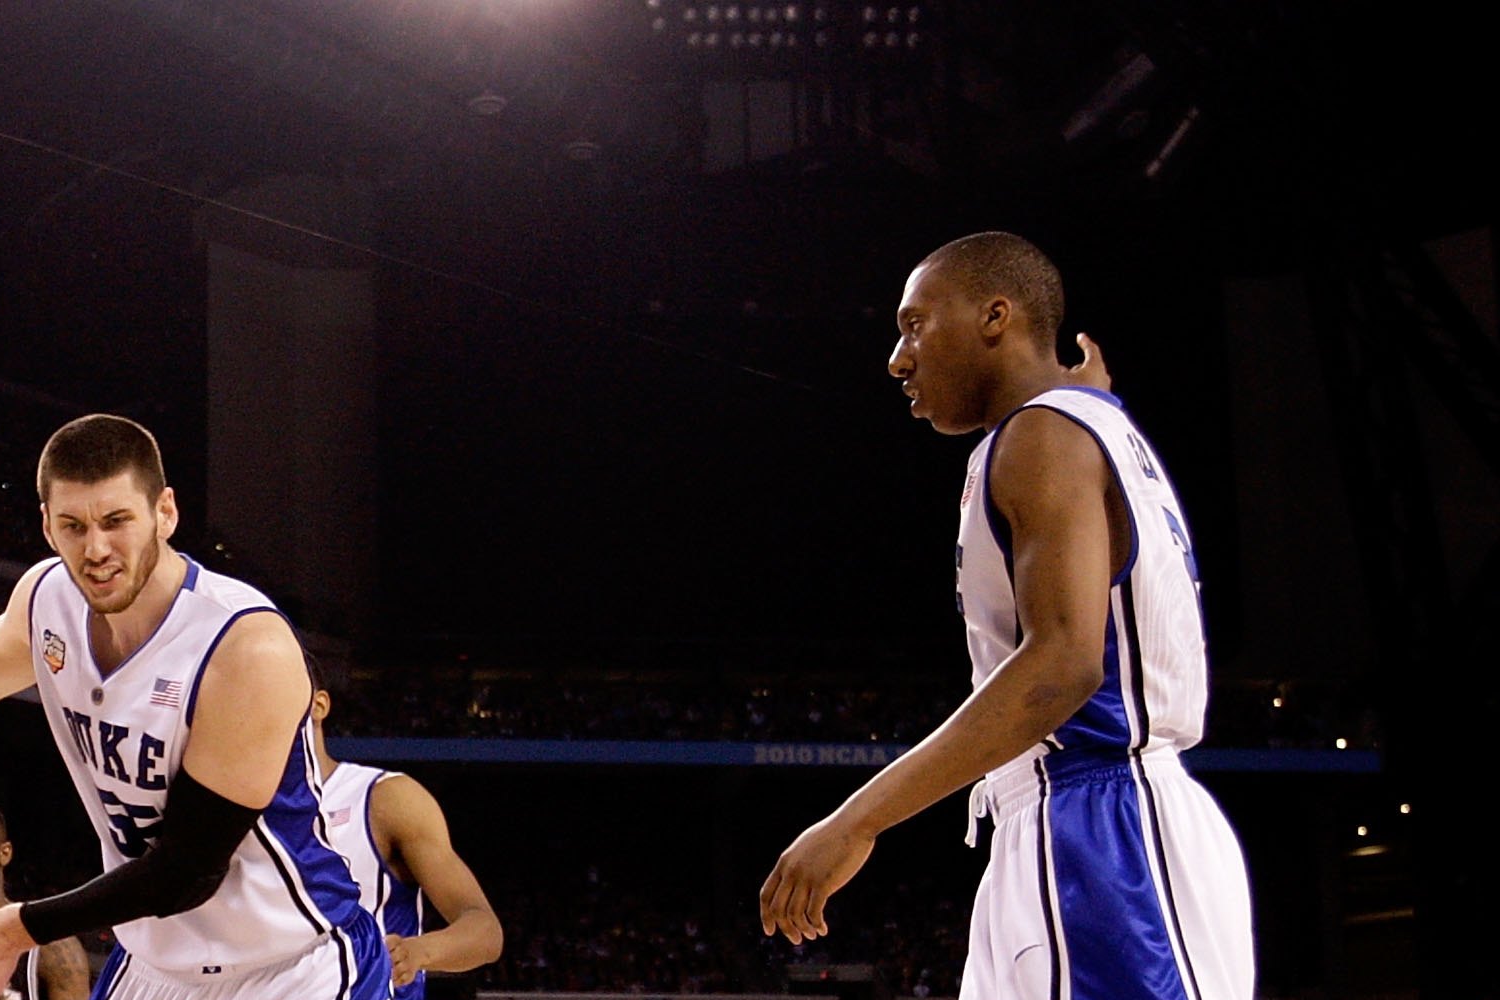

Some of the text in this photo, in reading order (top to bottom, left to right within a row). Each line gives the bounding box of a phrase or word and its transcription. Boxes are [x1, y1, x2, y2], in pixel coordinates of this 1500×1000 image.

[62, 707, 167, 791] DUKE
[754, 743, 814, 766] 2010
[818, 744, 887, 766] NCAA
